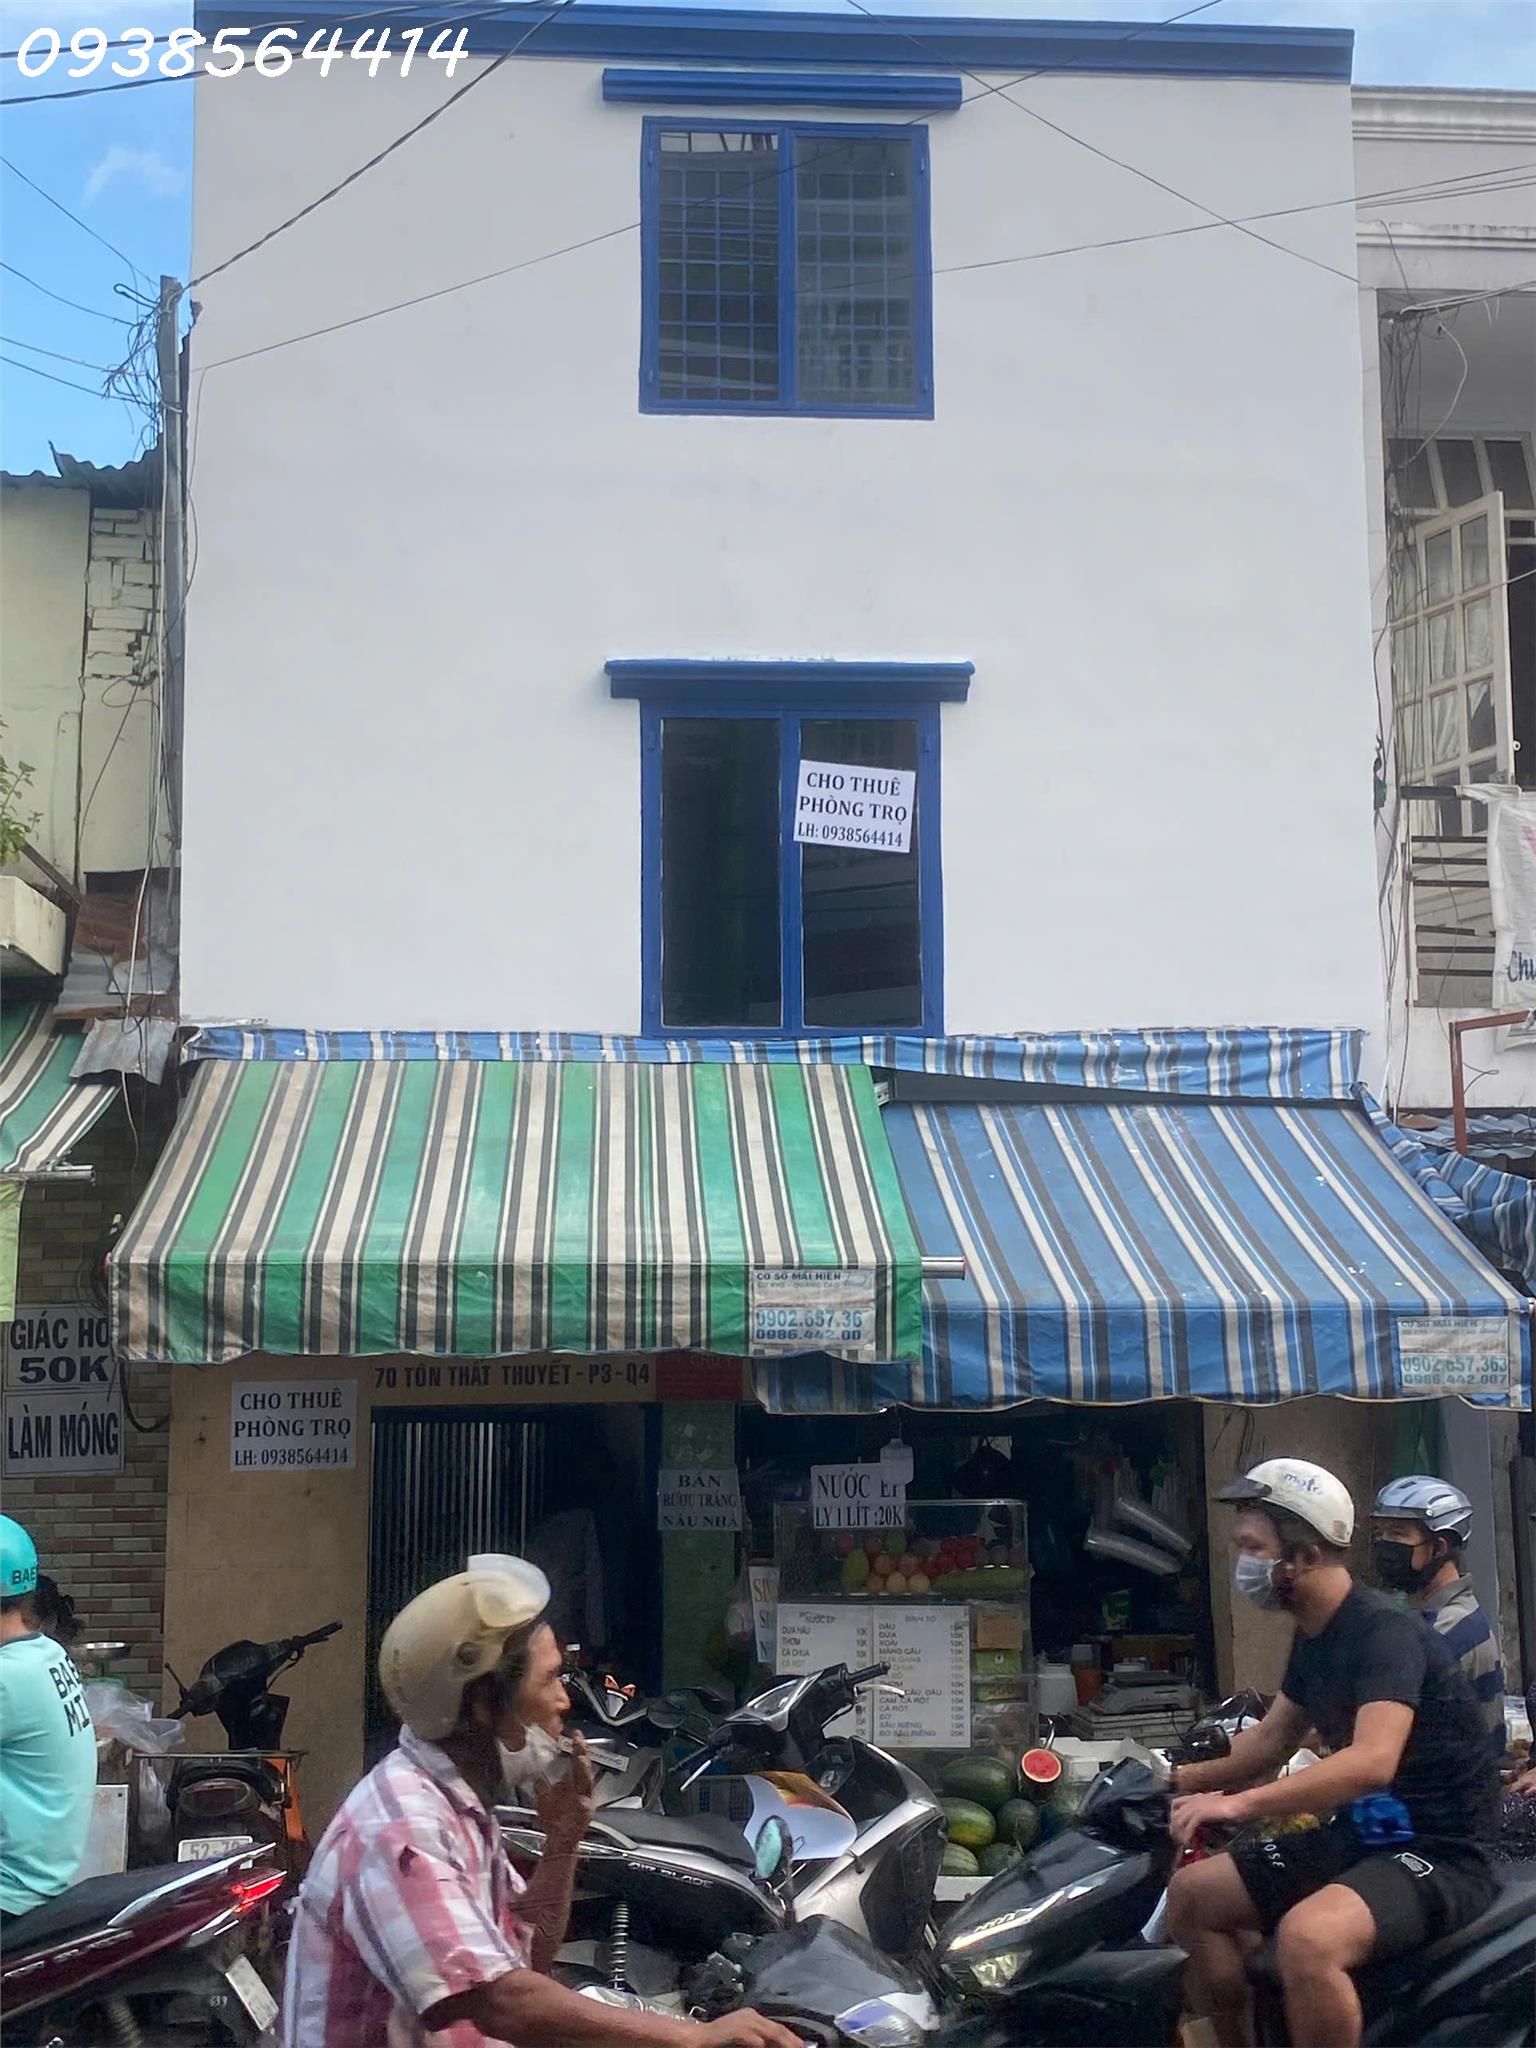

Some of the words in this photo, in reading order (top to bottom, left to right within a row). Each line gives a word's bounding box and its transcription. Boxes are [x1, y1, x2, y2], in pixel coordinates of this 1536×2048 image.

[806, 772, 845, 791] CHO
[849, 776, 902, 796] THUÊ
[799, 794, 864, 818] PHÒNG
[868, 804, 908, 825] TRỌ
[797, 821, 820, 838] LH:
[821, 824, 903, 847] 0938564414
[9, 1310, 69, 1350] GIÁC
[19, 1355, 109, 1384] 50K
[374, 1367, 398, 1388] 70
[404, 1364, 441, 1388] TÔN
[240, 1392, 282, 1411] CHO
[287, 1386, 342, 1409] THUÊ
[8, 1404, 52, 1459] LÀM
[59, 1401, 119, 1457] MÓNG
[233, 1416, 305, 1438] PHÒNG
[310, 1418, 351, 1440] TRỌ
[234, 1449, 257, 1466] LH:
[260, 1447, 348, 1466] 0938564414
[818, 1467, 871, 1499] NƯỚC
[815, 1506, 833, 1527] LY
[846, 1500, 871, 1526] LÍT
